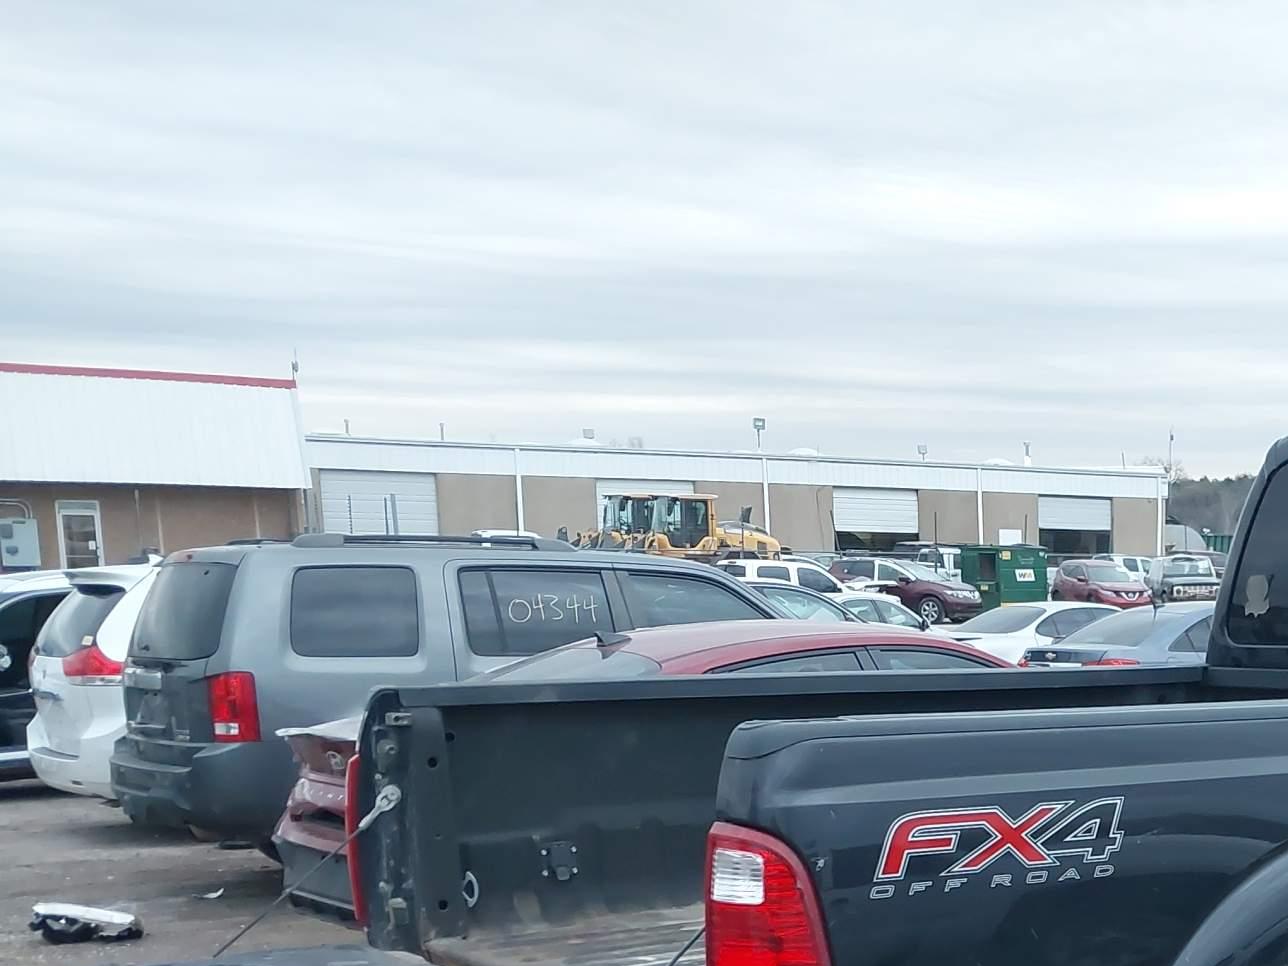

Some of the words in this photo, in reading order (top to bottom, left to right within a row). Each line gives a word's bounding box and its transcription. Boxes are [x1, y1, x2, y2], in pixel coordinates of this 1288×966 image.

[508, 593, 599, 625] 04344
[873, 796, 1125, 882] FX4
[869, 878, 968, 900] OFF
[990, 865, 1115, 887] ROAD
